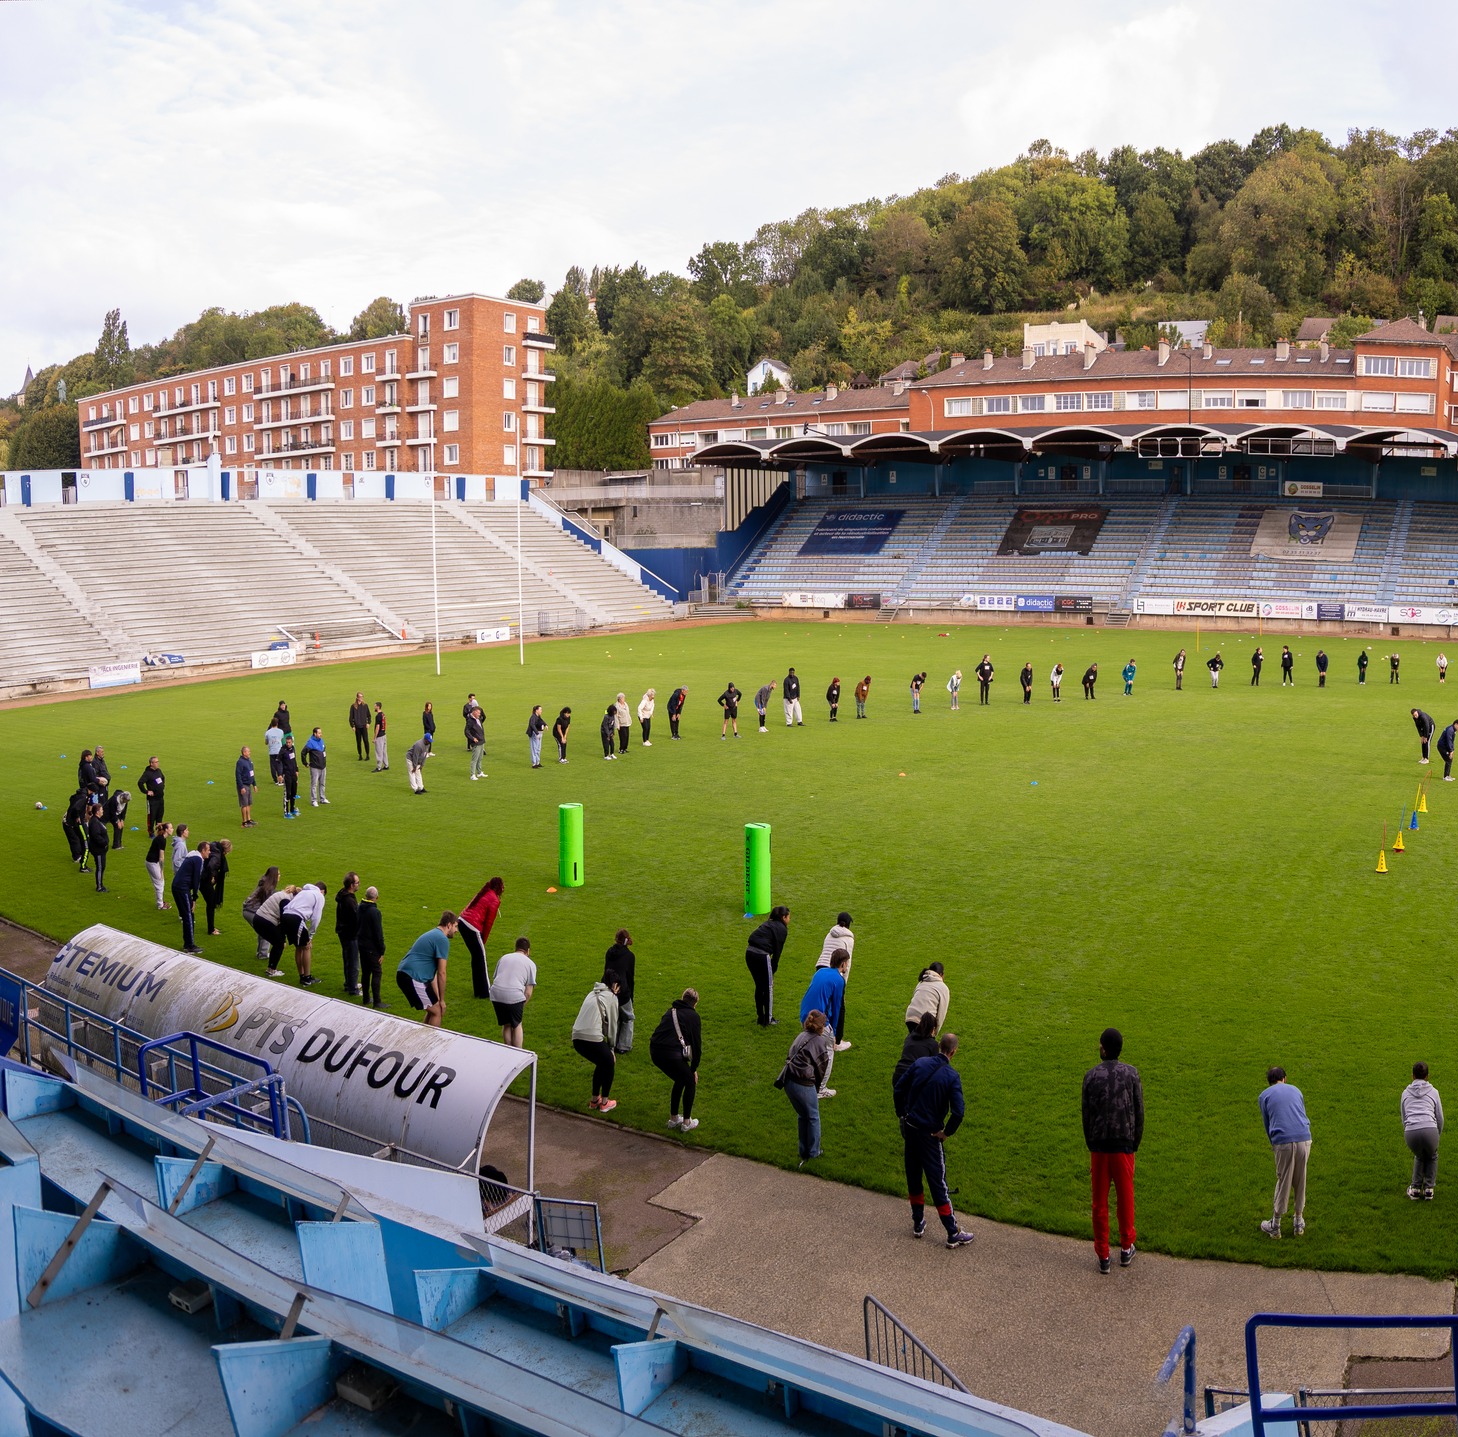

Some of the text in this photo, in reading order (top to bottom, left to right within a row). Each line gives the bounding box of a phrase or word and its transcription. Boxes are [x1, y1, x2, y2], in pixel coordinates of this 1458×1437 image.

[838, 512, 885, 521] didactic
[1026, 598, 1053, 607] didactic
[1186, 601, 1225, 612] SPORT
[1226, 603, 1256, 613] CLUB
[112, 663, 138, 671] INGENIERIE
[234, 1006, 457, 1110] PTS DUFOUR
